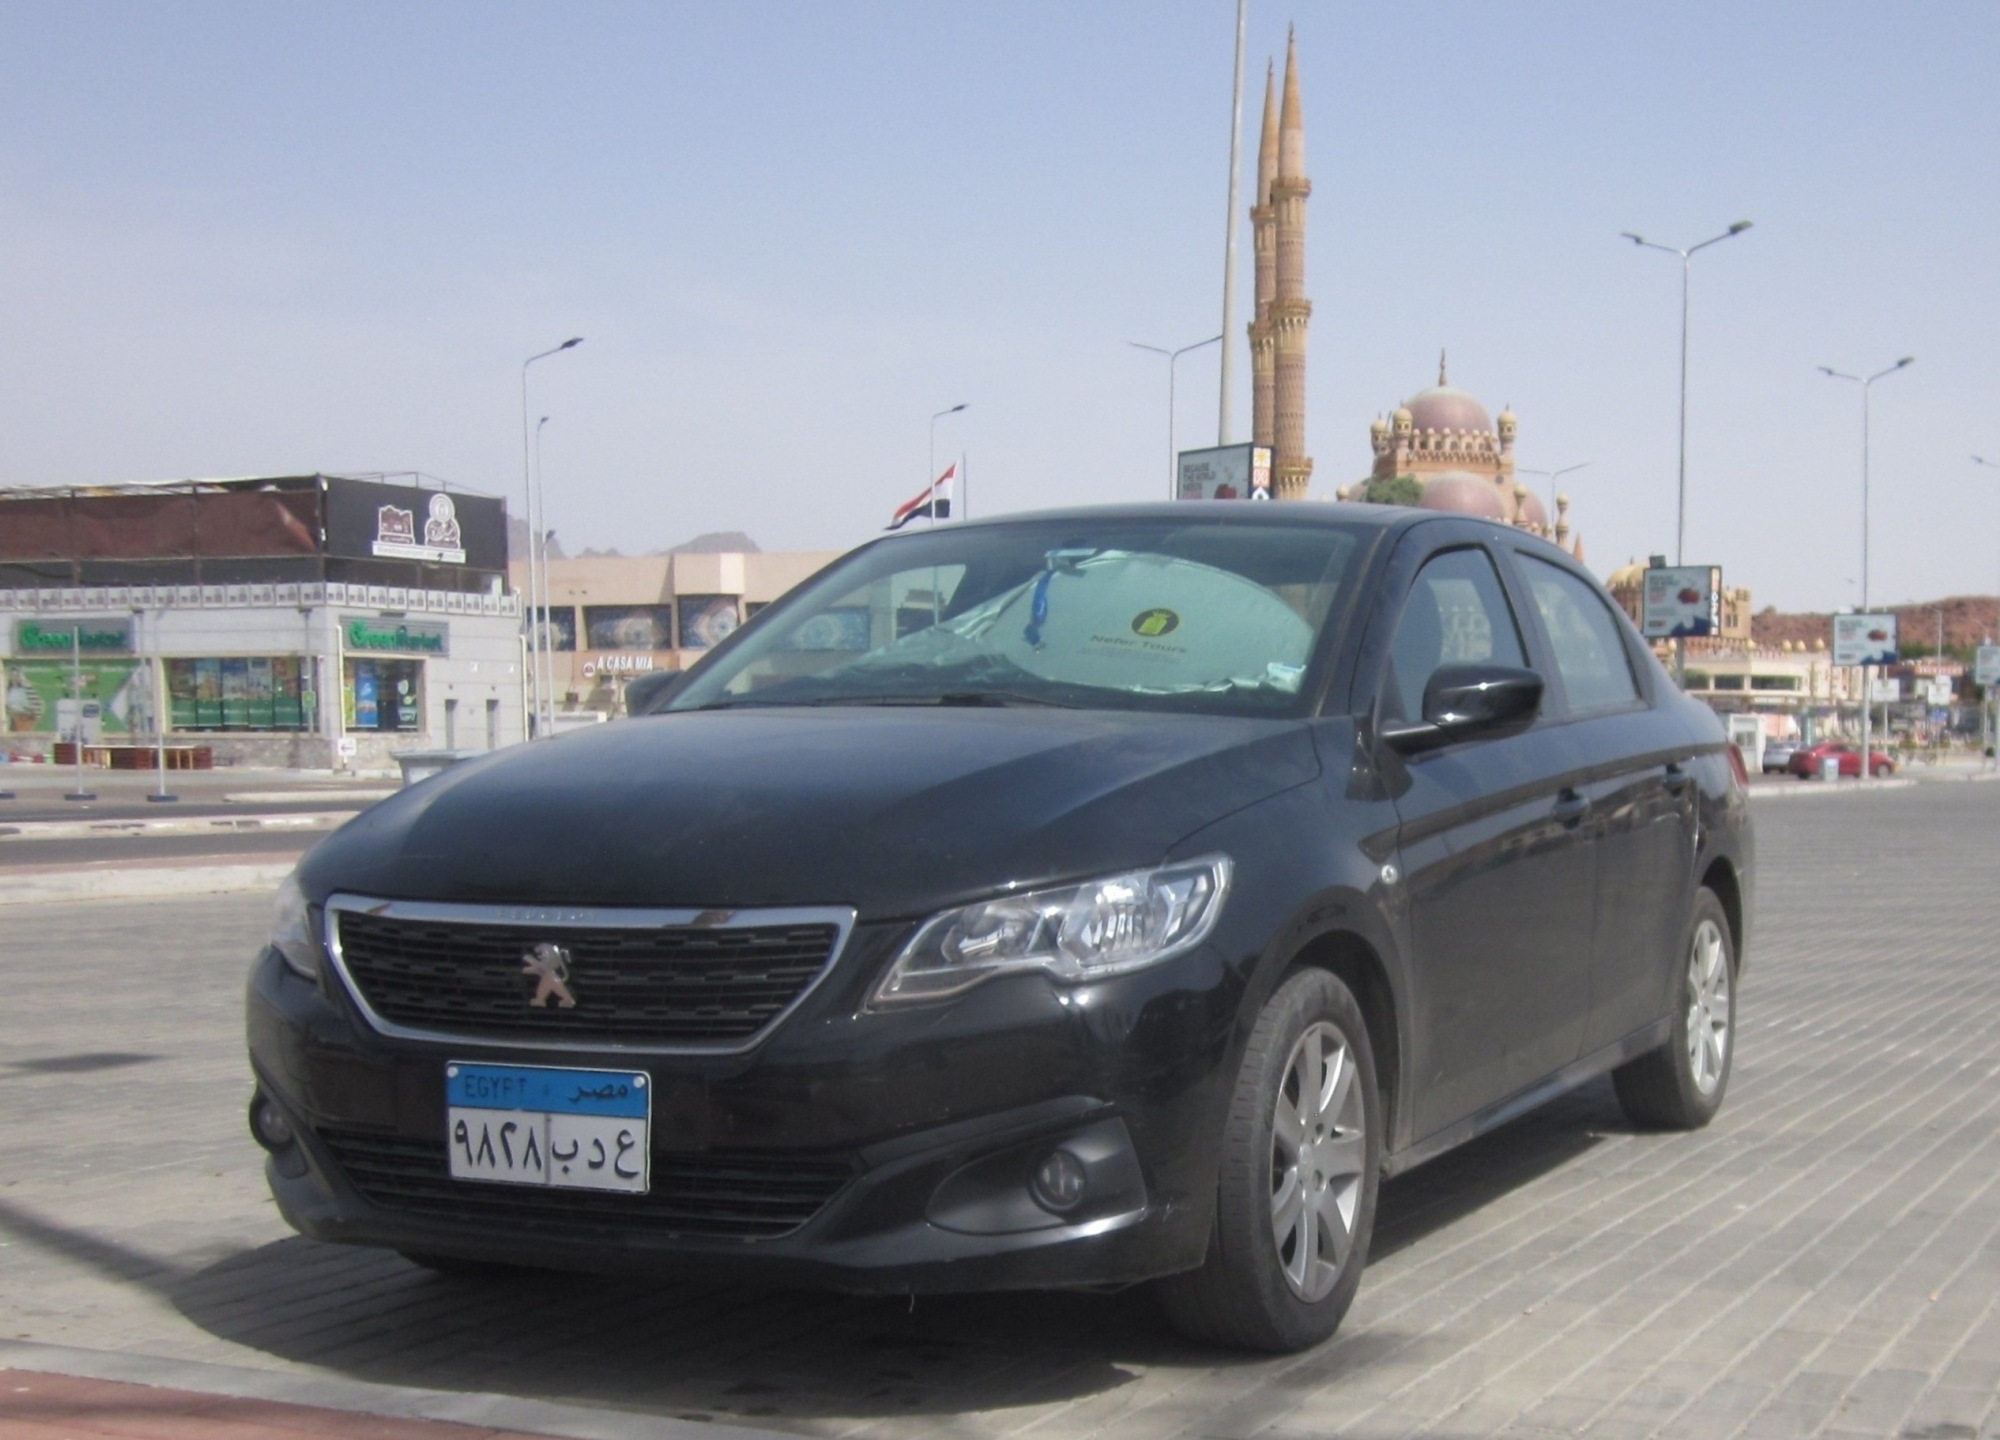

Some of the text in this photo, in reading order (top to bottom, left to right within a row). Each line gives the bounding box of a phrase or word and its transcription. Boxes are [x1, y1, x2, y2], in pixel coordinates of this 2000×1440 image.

[1090, 634, 1188, 654] Nefer Tours
[597, 656, 653, 671] A CASA MIA
[464, 1074, 528, 1098] EGYPT
[569, 1082, 628, 1104] مصر
[454, 1118, 542, 1171] ٩٨٢٨
